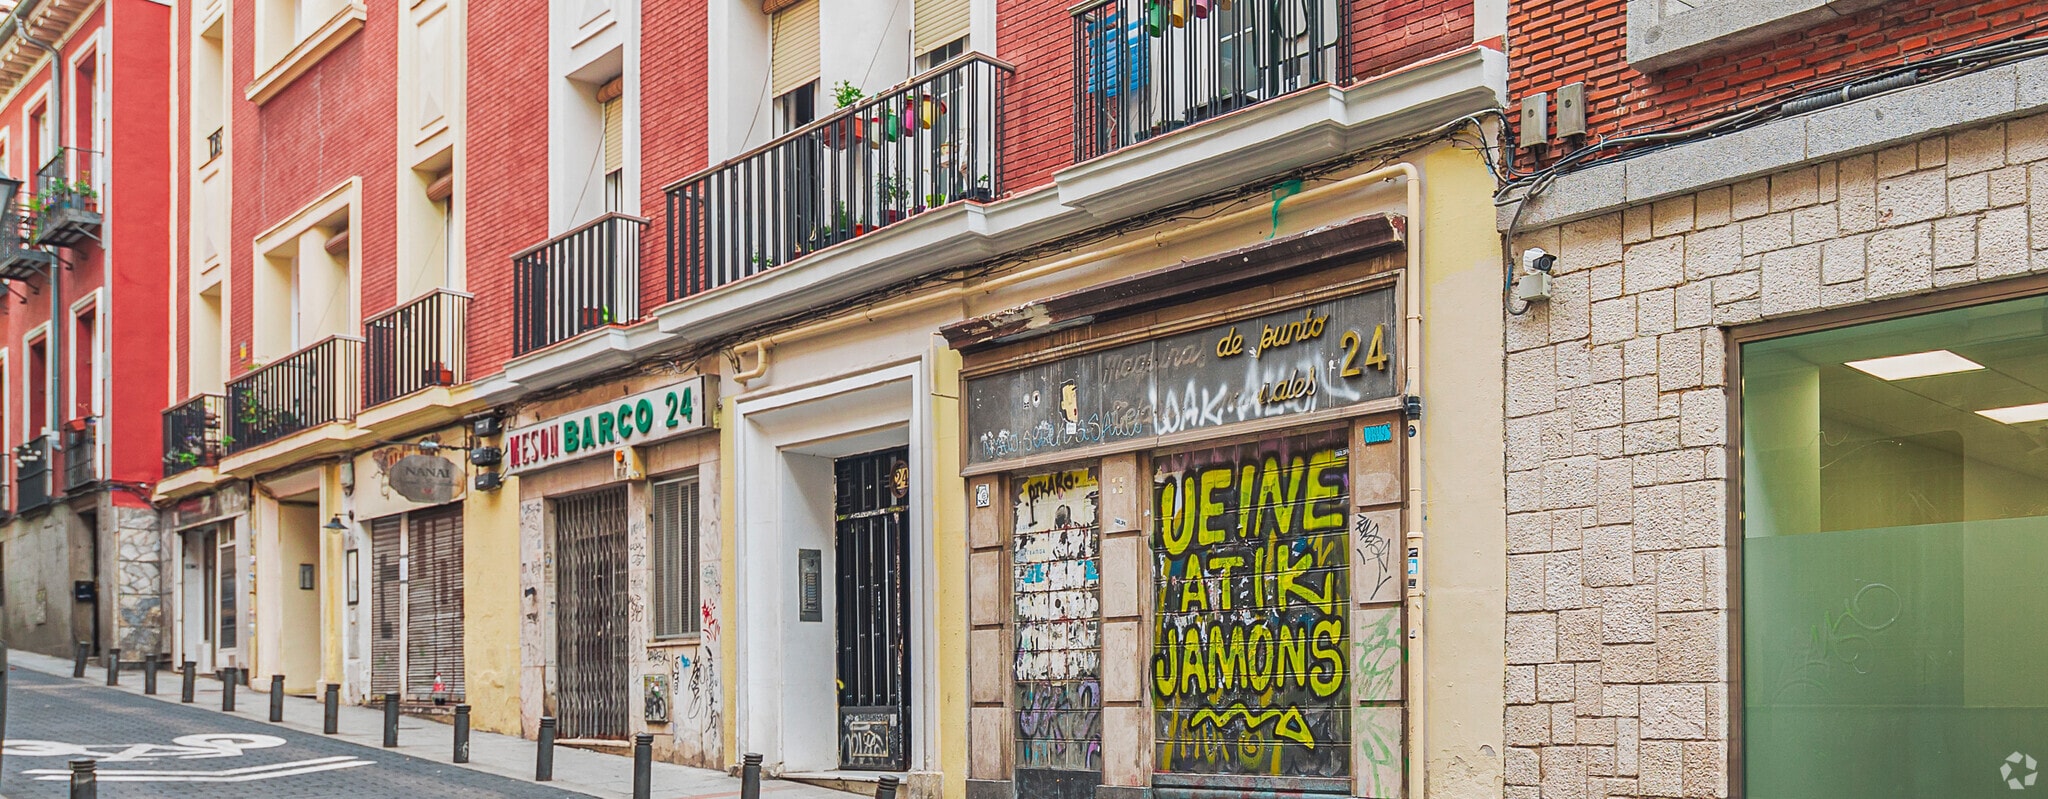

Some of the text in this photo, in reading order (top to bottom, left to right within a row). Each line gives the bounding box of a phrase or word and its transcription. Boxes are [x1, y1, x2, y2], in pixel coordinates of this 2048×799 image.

[1217, 326, 1244, 357] de
[1256, 309, 1330, 359] punto
[1339, 323, 1388, 378] 24
[509, 386, 694, 468] MESON BARCO 24
[894, 467, 909, 489] 24
[1155, 618, 1346, 698] JAMONS
